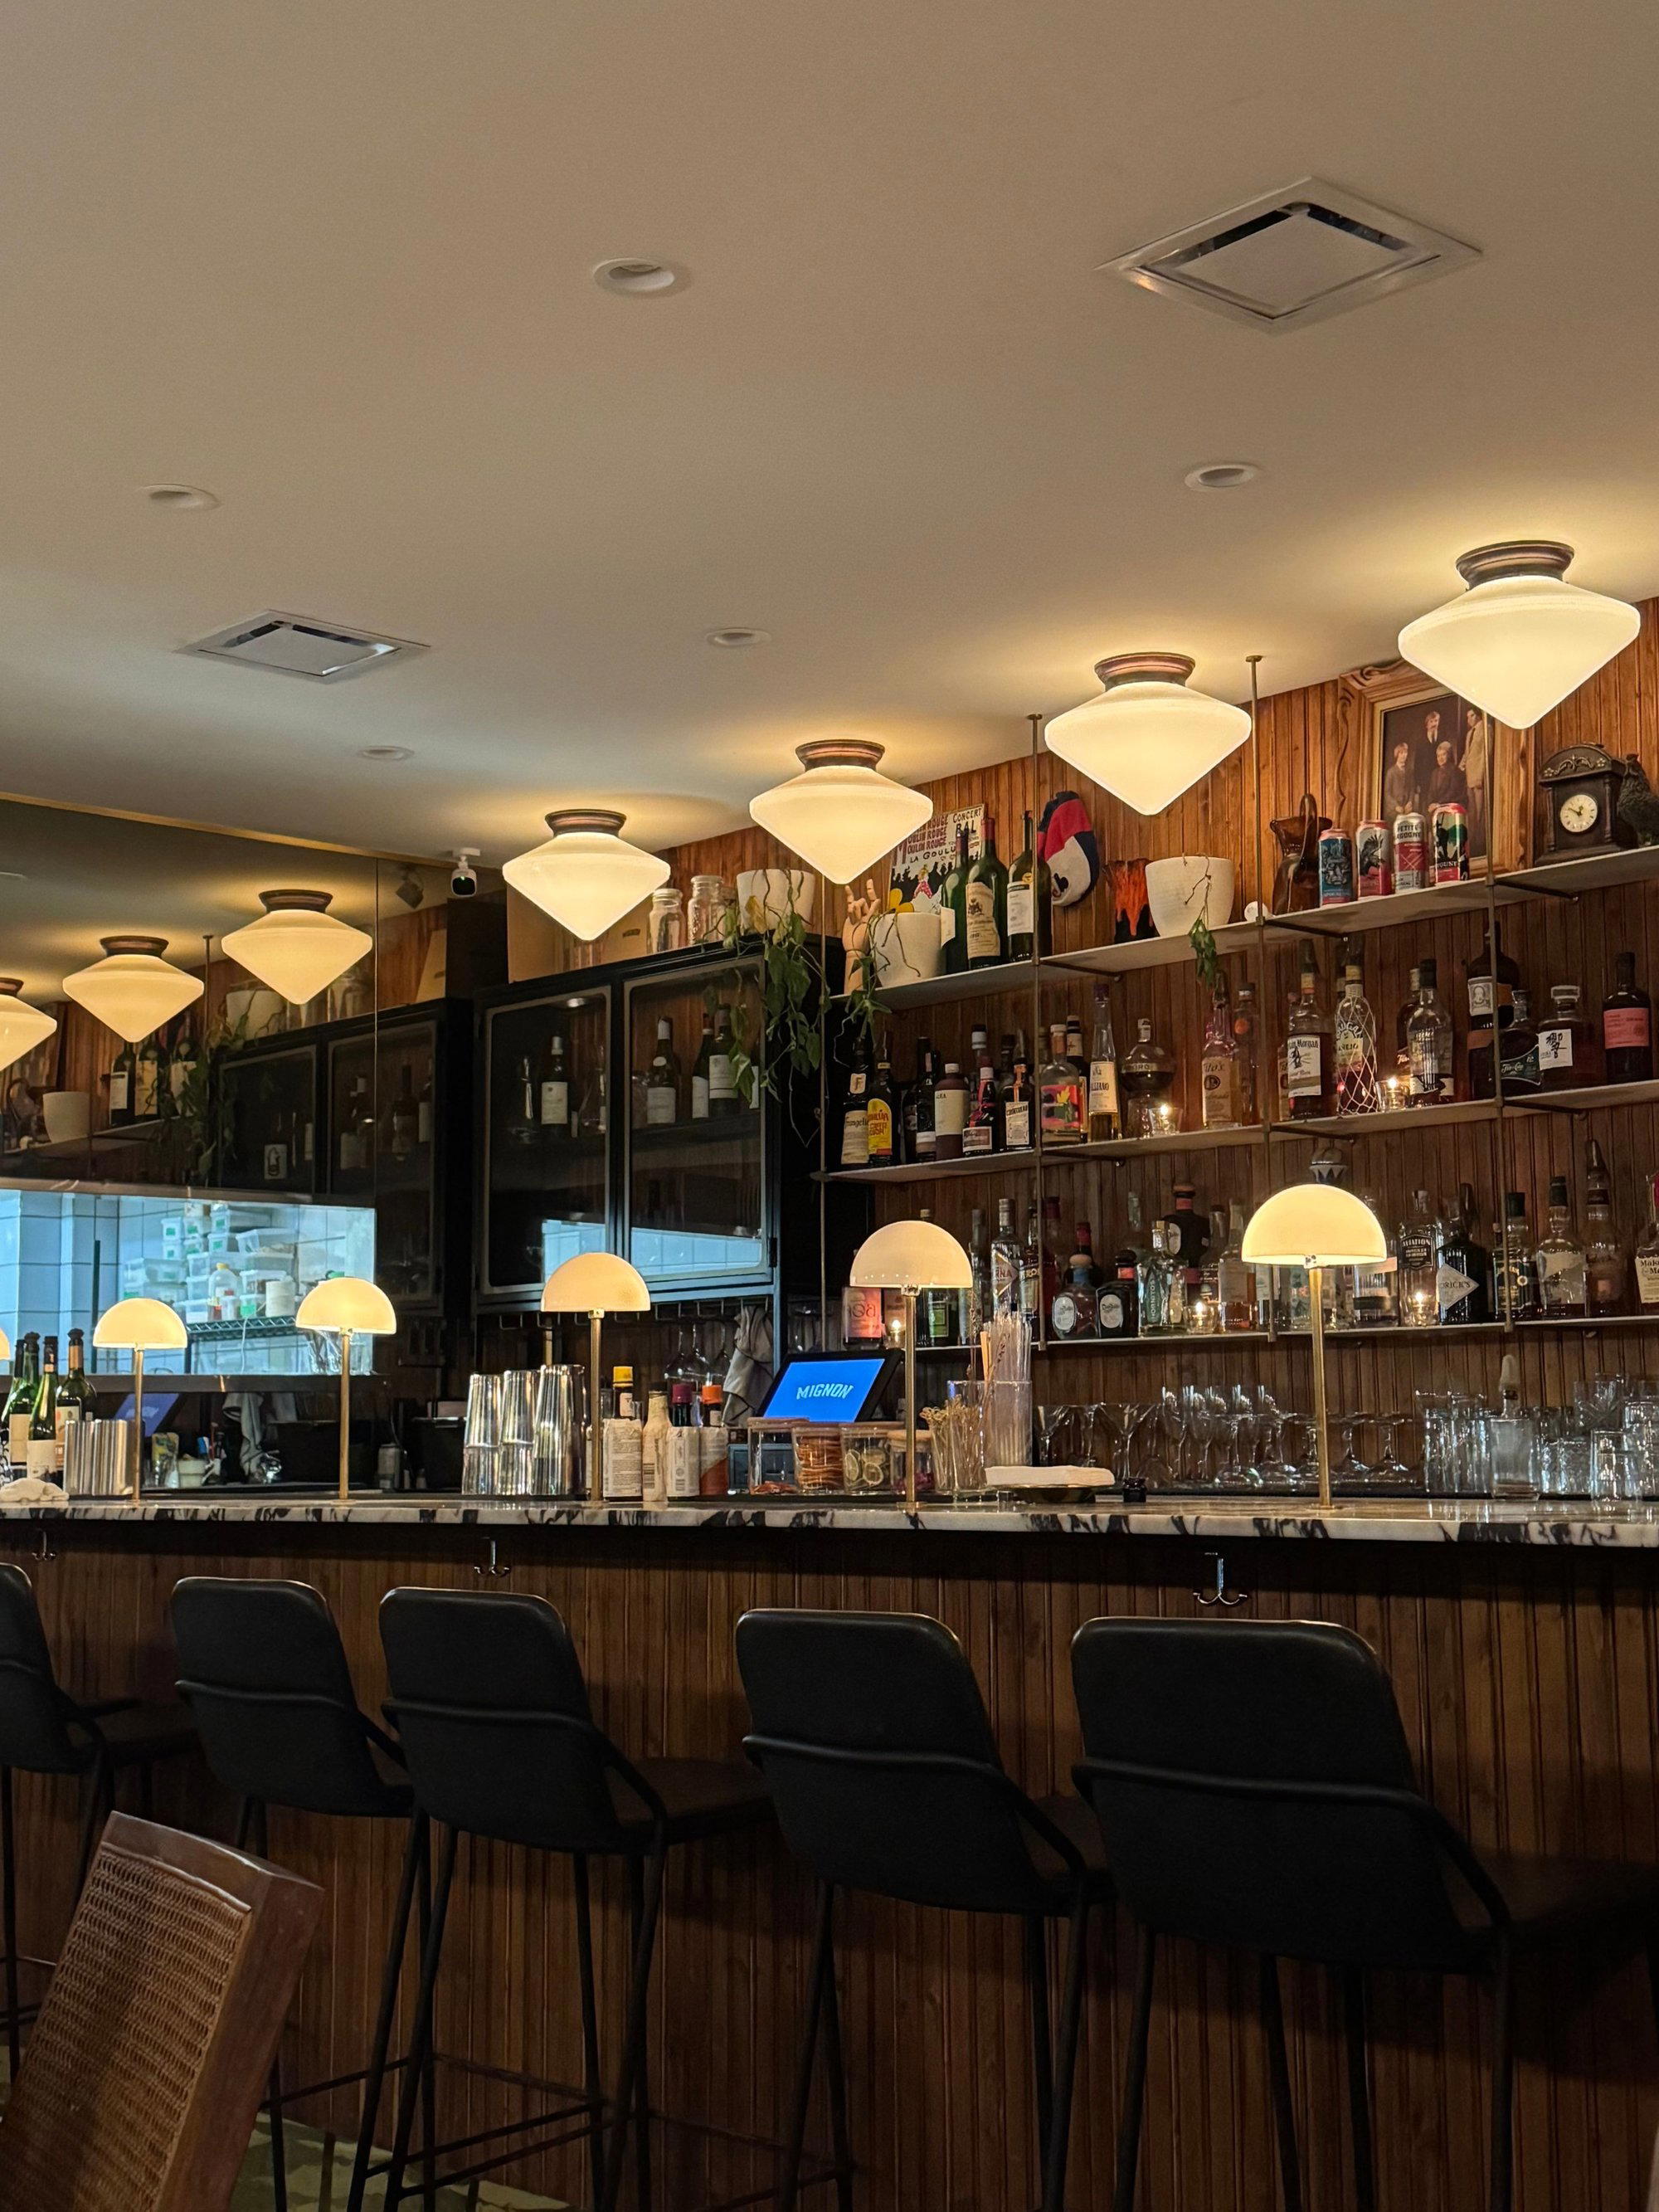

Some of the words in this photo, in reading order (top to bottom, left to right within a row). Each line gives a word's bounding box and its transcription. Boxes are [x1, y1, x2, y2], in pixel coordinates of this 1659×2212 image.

[952, 807, 982, 823] CONCERT
[927, 826, 946, 840] ROUGE
[926, 836, 946, 850] ROUGE
[910, 855, 919, 864] LA
[922, 846, 956, 860] GOULU
[854, 1076, 863, 1091] F
[796, 1383, 854, 1400] MIGNON
